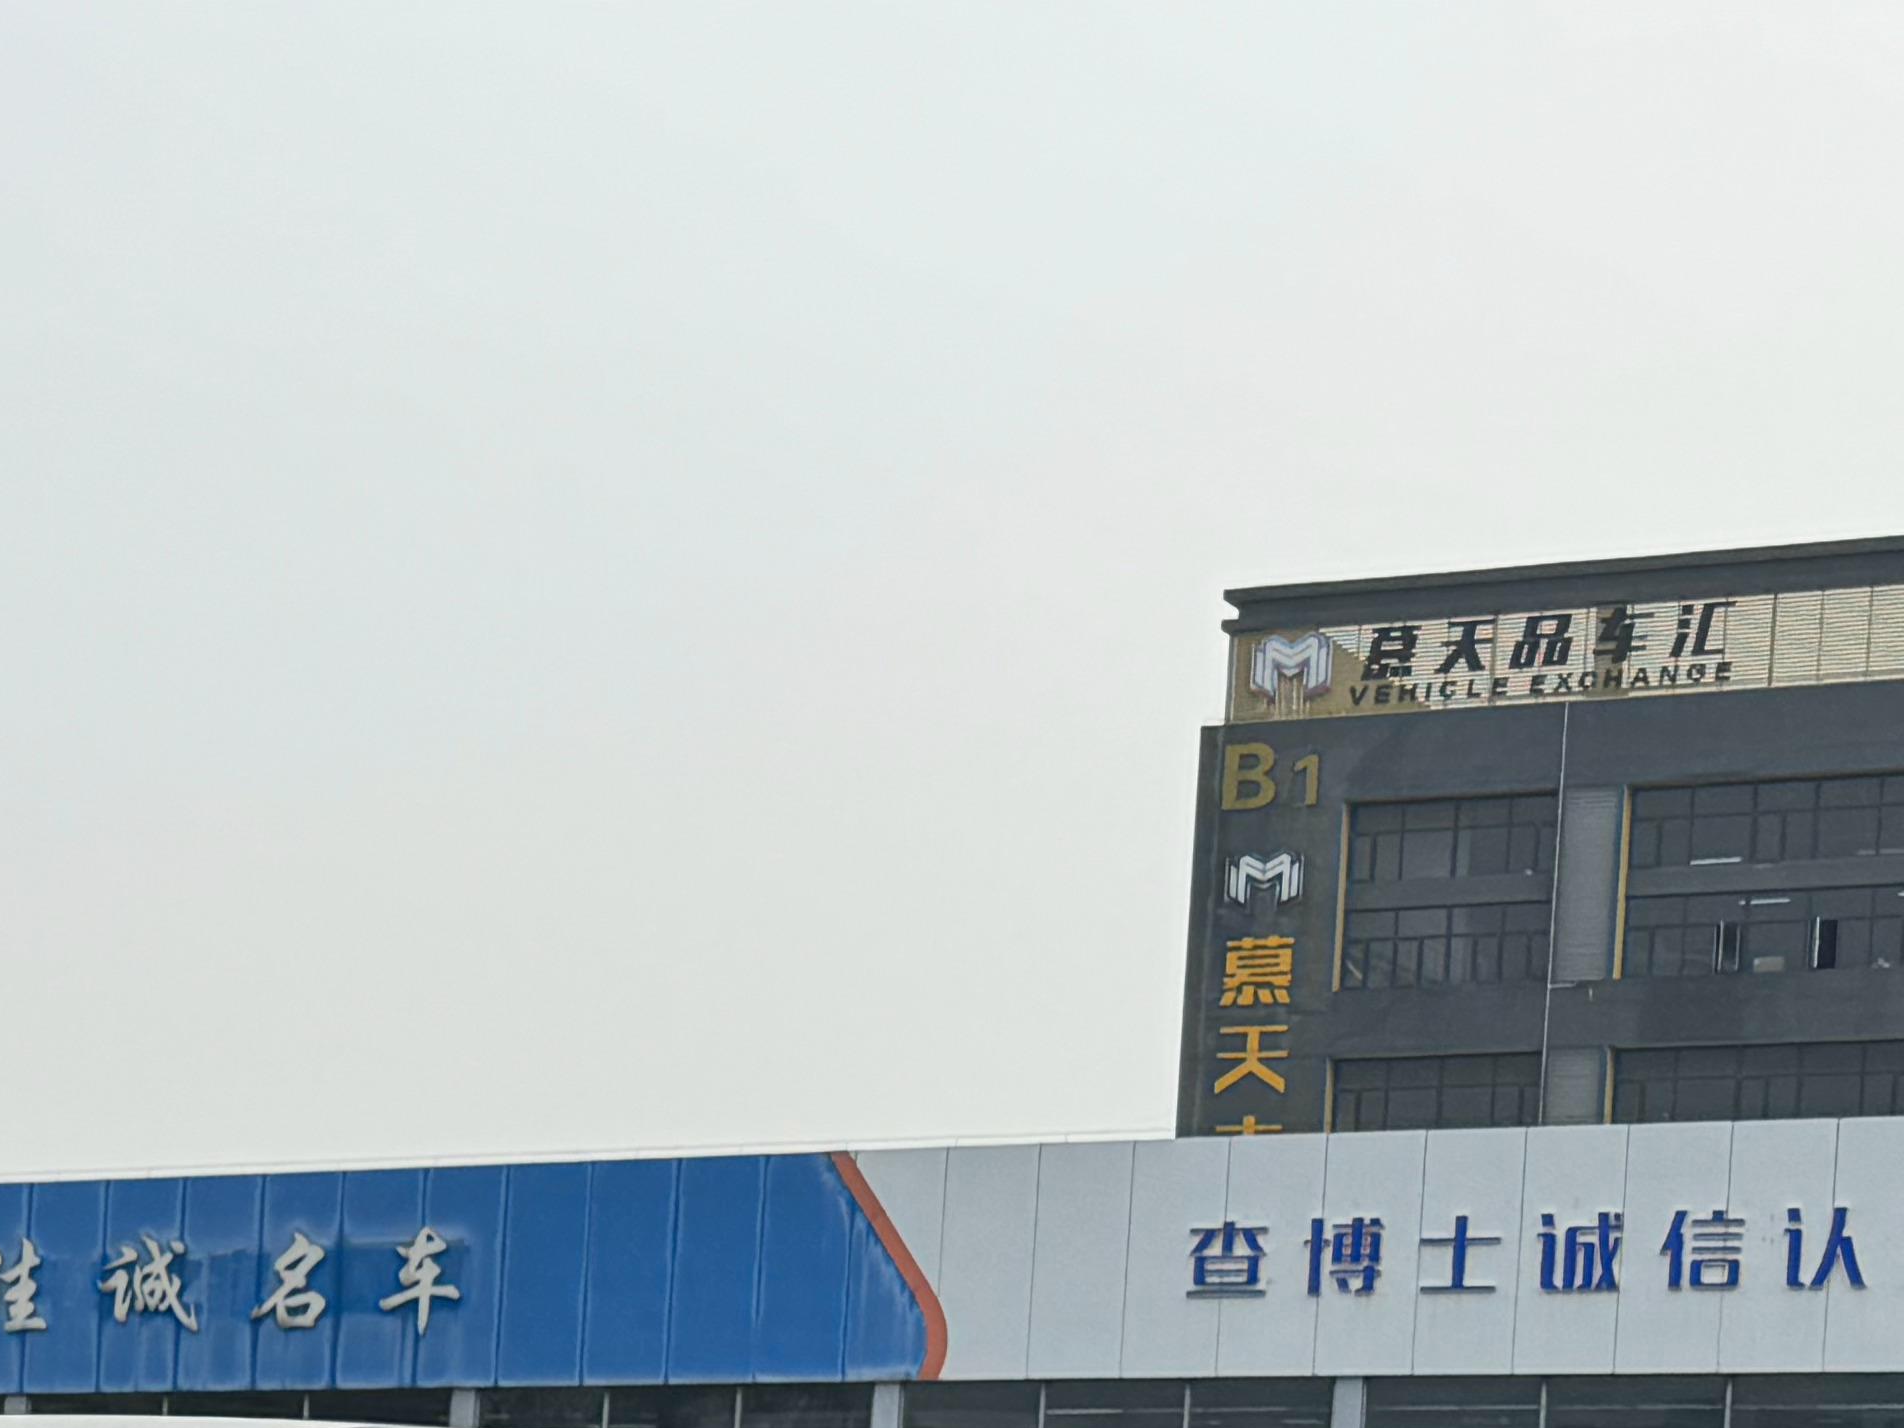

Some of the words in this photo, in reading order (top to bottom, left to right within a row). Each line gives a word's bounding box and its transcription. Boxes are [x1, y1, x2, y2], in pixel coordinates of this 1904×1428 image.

[1530, 661, 1732, 696] EXCHANGE
[1221, 742, 1320, 811] B1
[1186, 1205, 1868, 1299] 查博士诚信认
